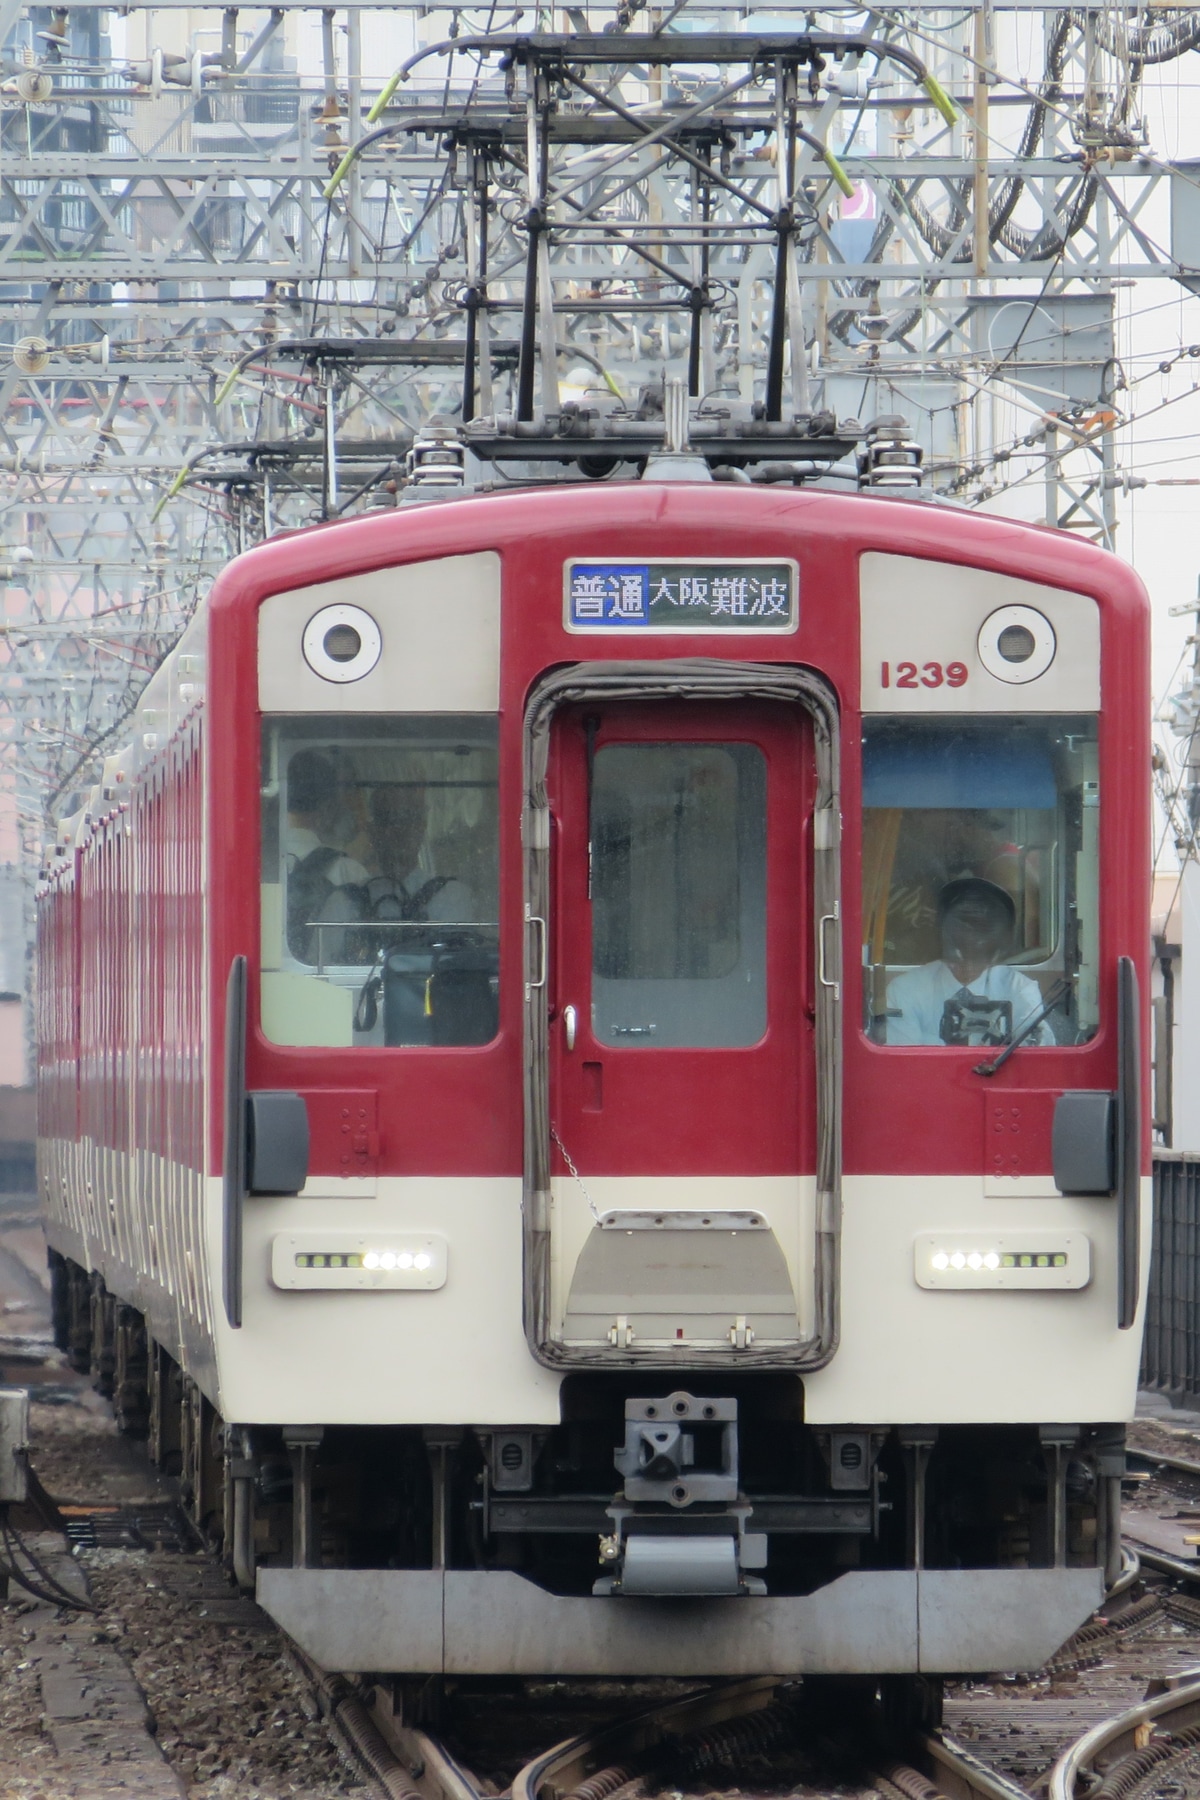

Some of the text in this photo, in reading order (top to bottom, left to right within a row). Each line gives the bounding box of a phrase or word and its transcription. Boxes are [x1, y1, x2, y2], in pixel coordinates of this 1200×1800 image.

[572, 575, 789, 618] 普通 大阪難波
[881, 661, 968, 688] 1239
